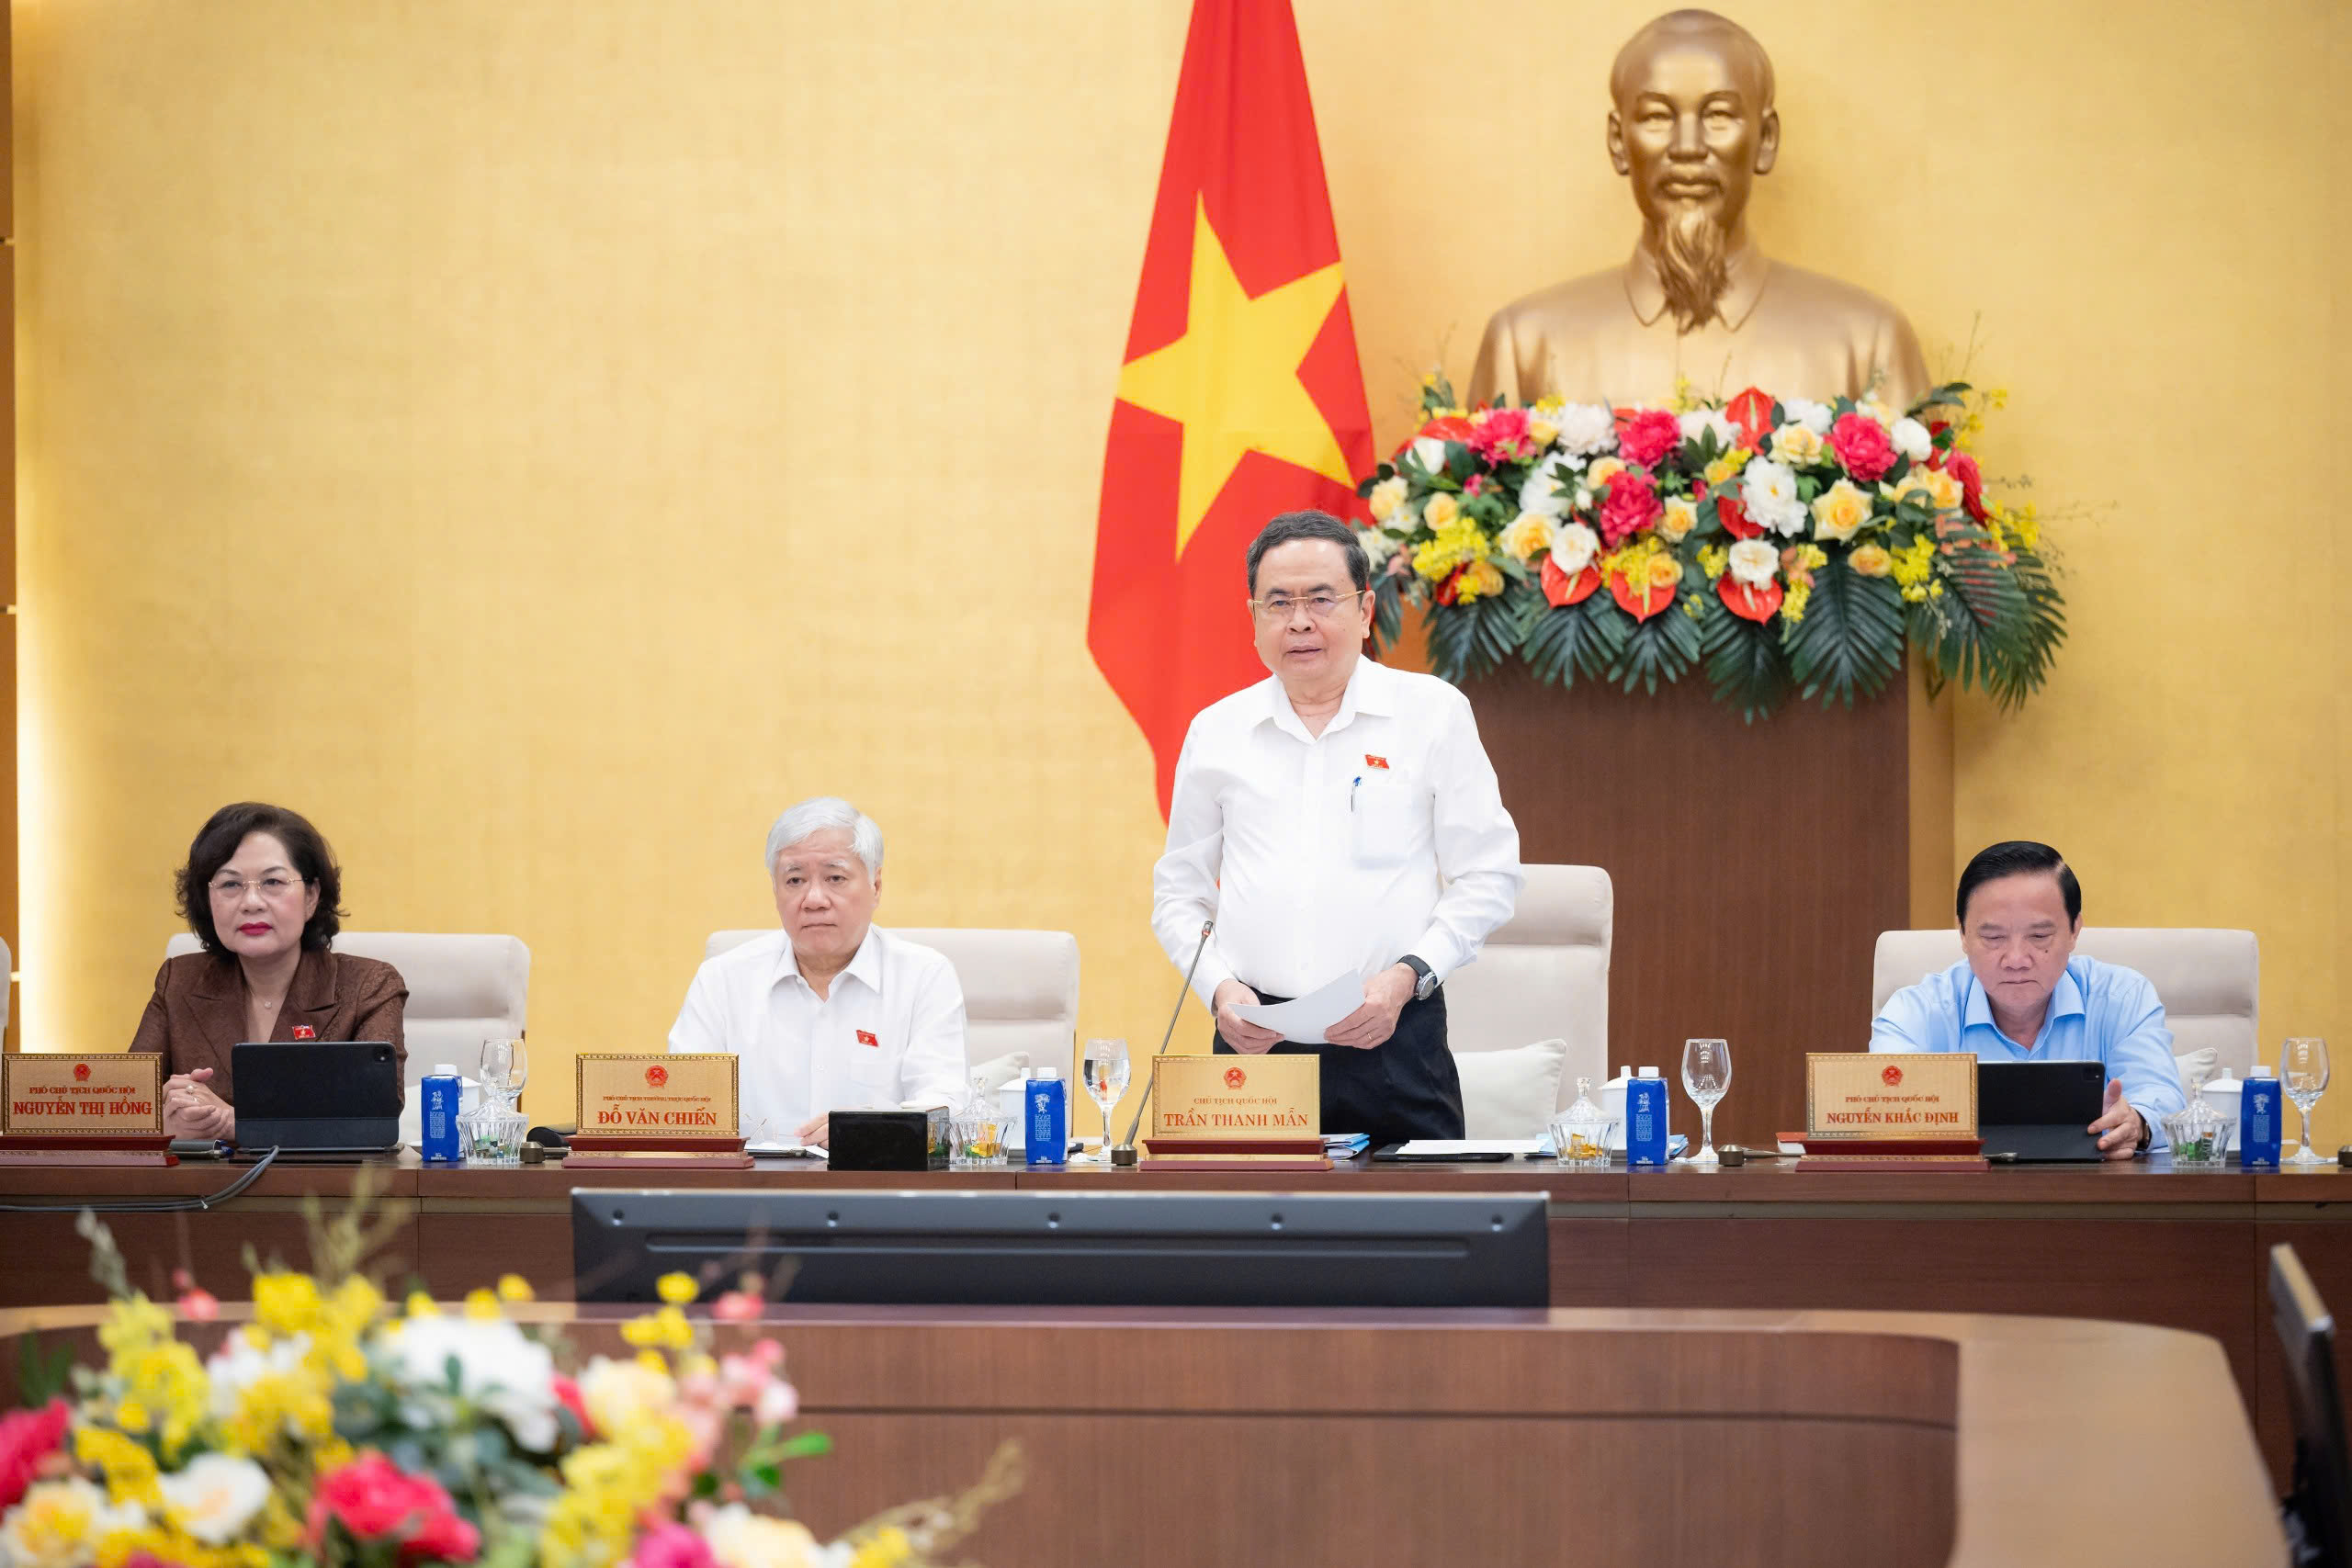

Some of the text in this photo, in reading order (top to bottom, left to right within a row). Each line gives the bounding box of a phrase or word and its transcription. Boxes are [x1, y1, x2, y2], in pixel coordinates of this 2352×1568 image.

[29, 1085, 135, 1095] PHÓ CHỦ TỊCH QUỐC HỘI
[1845, 1094, 1939, 1104] PHÓ CHỦ TỊCH QUỐC HỘI
[13, 1096, 152, 1117] NGUYỄN THỊ HỒNG
[1193, 1095, 1277, 1105] CHỦ TỊCH QUỐC HỘI
[597, 1103, 717, 1125] ĐỖ VĂN CHIẾN
[1163, 1107, 1309, 1126] TRẦN THANH MẪN
[1826, 1107, 1959, 1125] NGUYỄN KHẮC ĐỊNH
